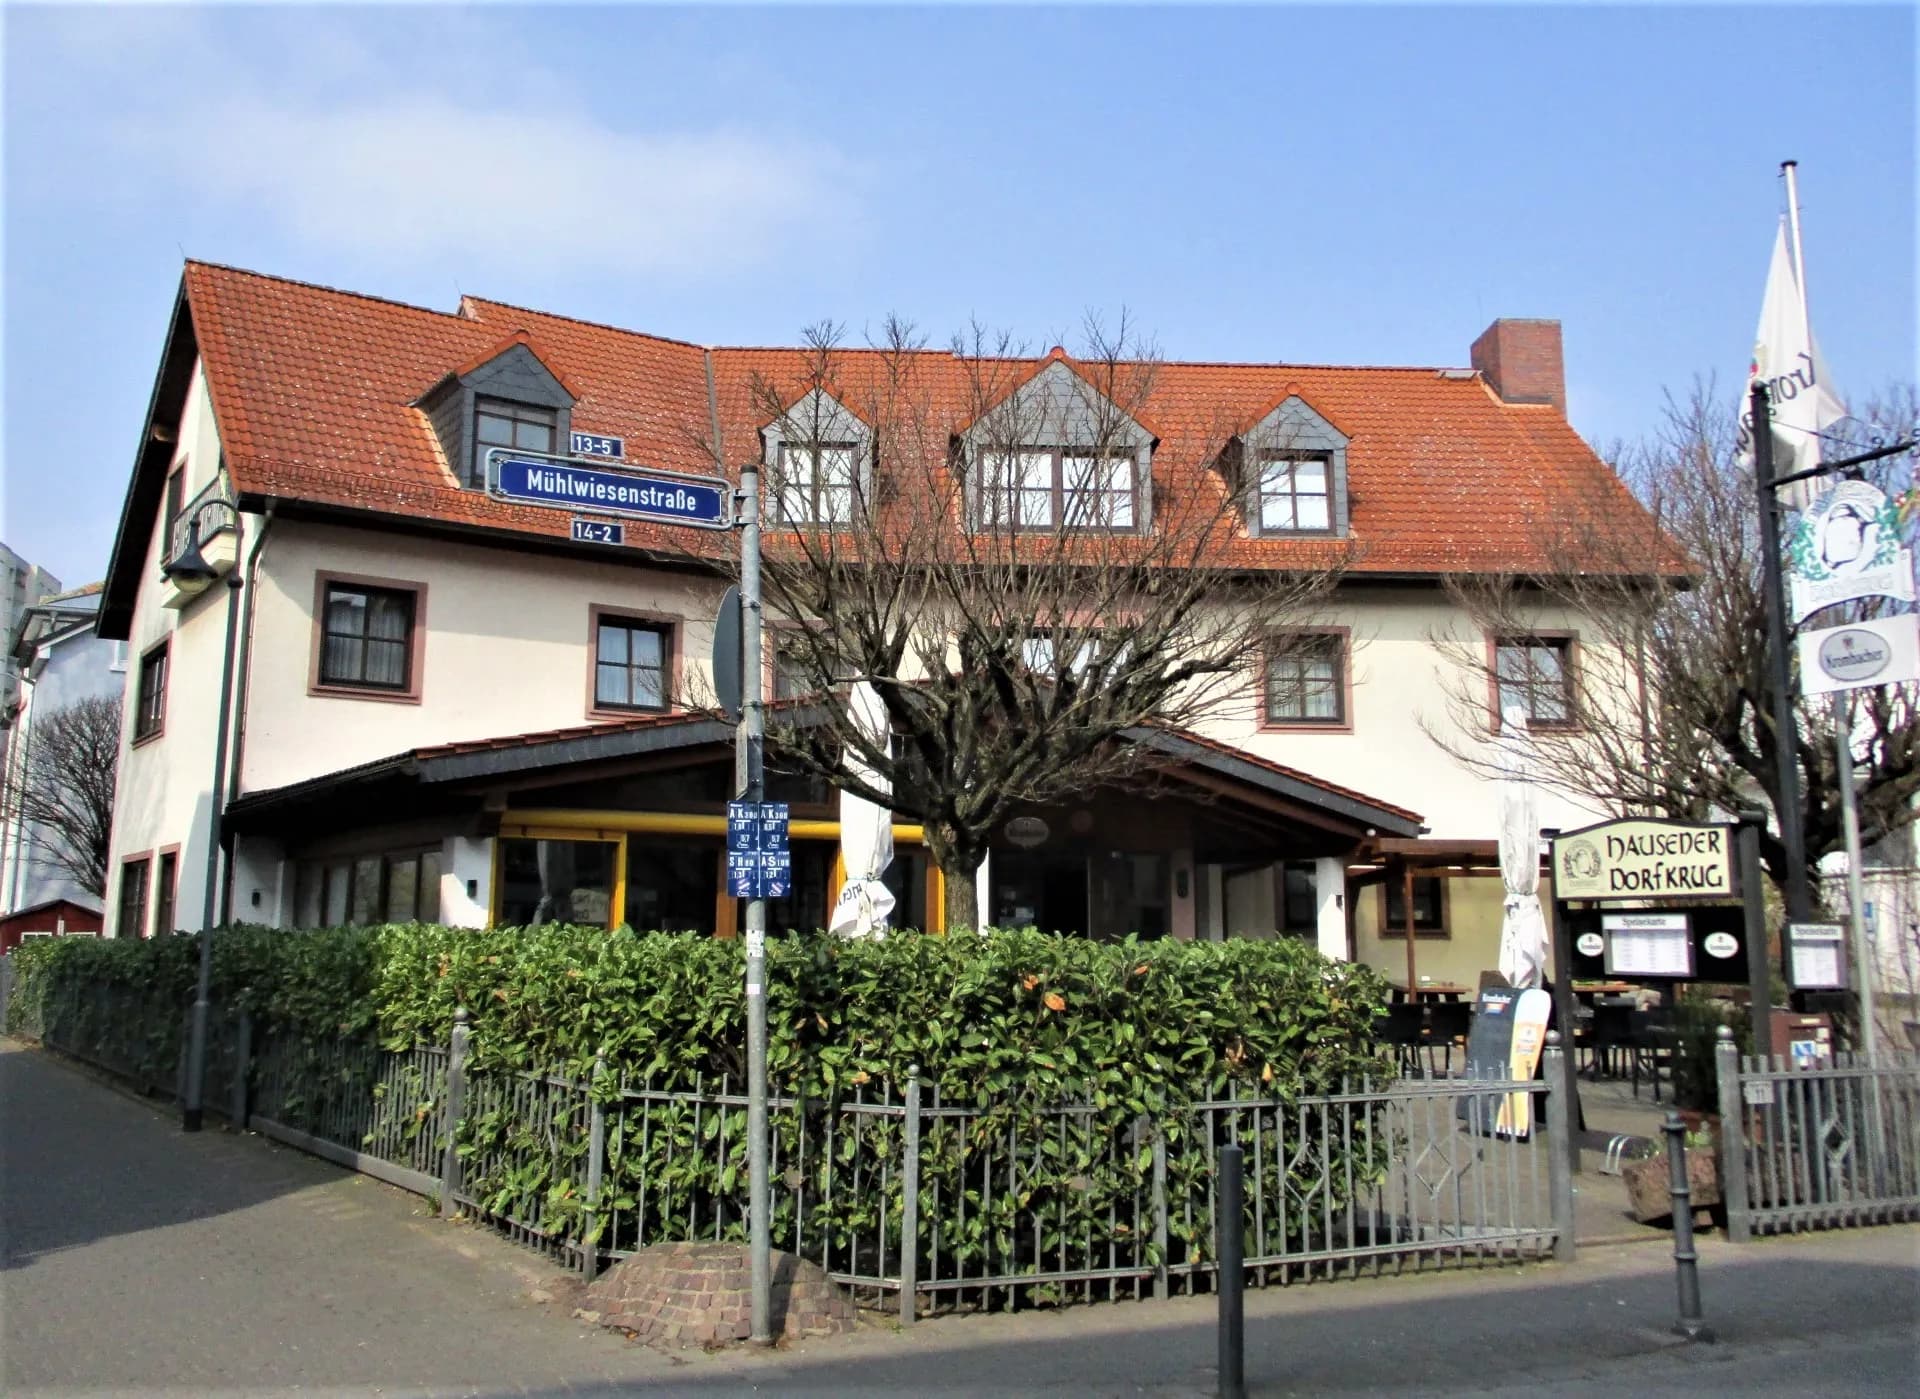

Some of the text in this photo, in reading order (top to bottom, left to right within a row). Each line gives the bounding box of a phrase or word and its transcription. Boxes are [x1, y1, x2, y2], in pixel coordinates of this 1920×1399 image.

[575, 435, 612, 456] 13-5
[527, 468, 697, 512] Mühlwiesenstraße
[575, 522, 612, 542] 14-2
[1610, 861, 1723, 891] DORFKRUG
